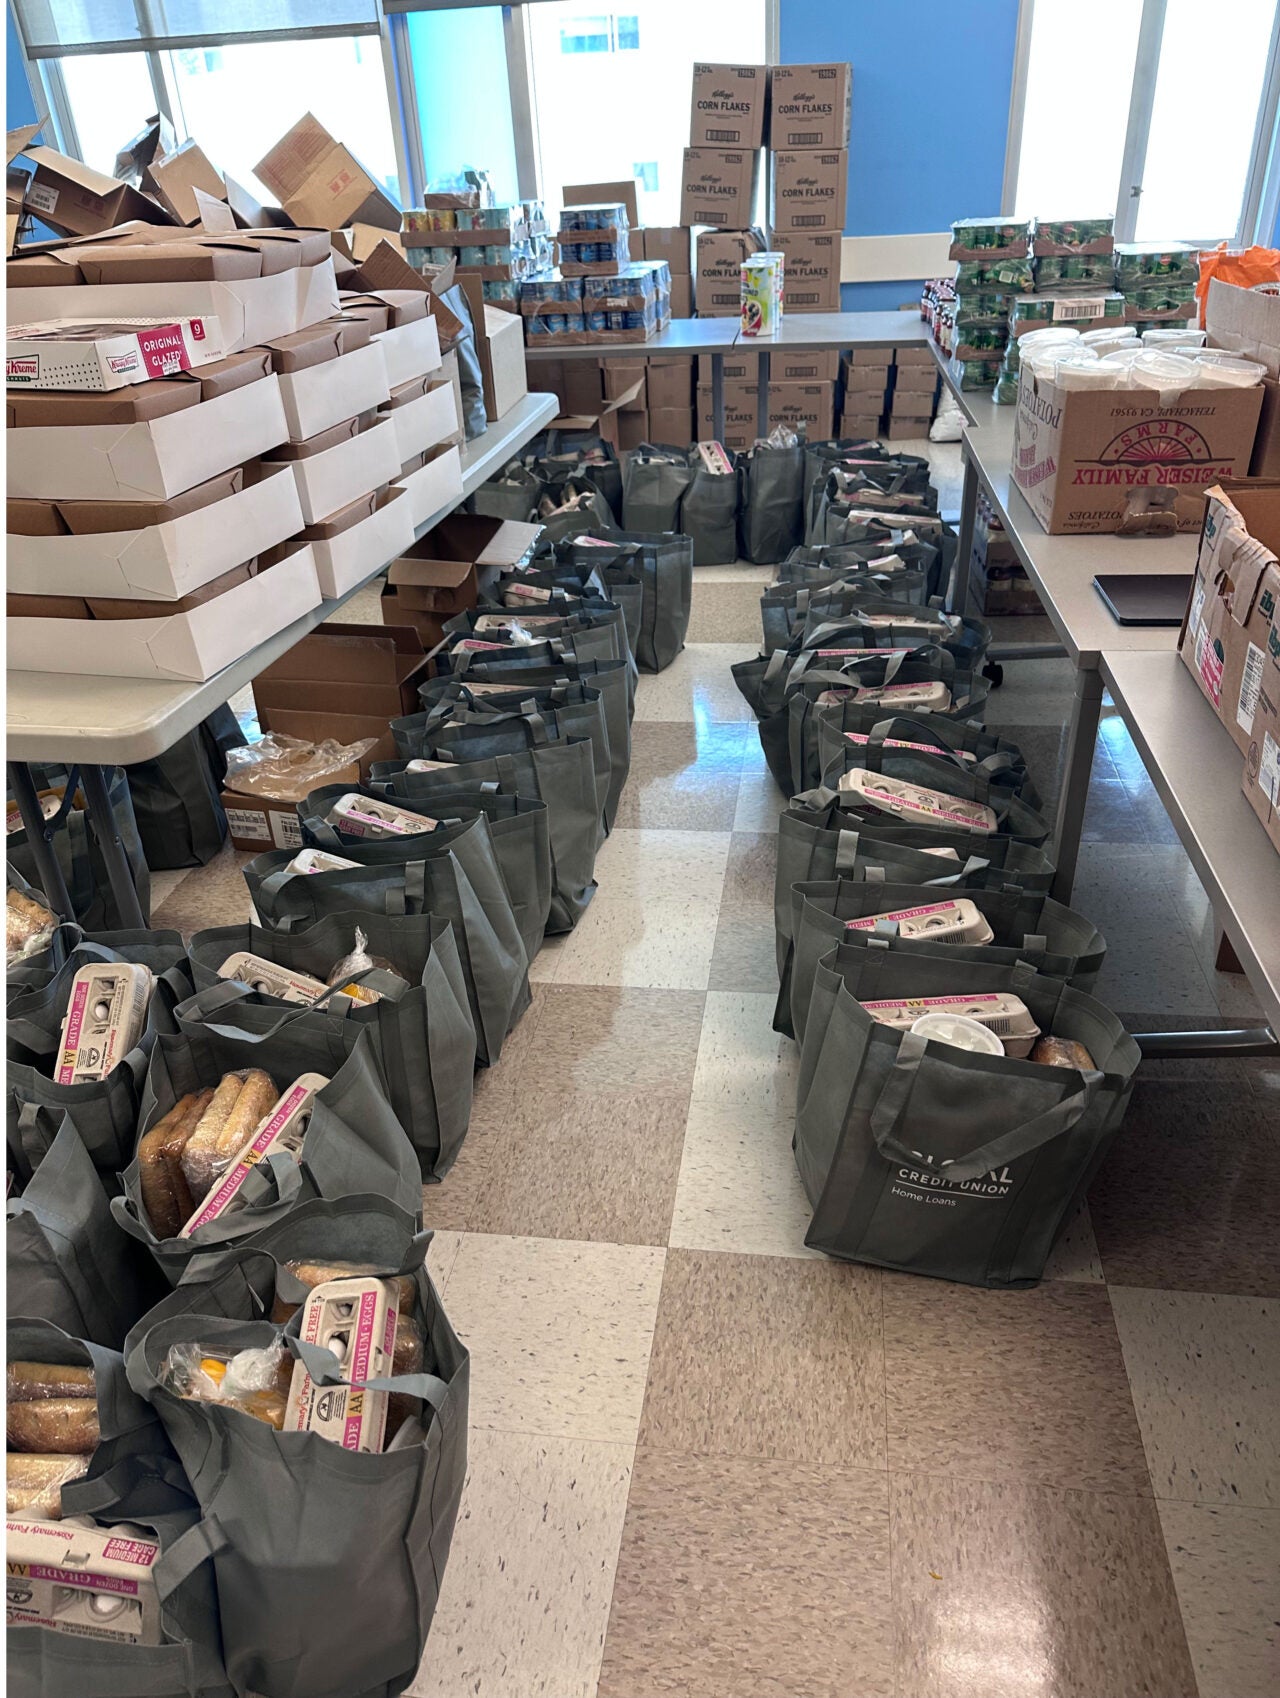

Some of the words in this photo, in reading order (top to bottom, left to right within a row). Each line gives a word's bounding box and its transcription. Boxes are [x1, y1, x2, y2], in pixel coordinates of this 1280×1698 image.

[697, 101, 719, 110] CORN
[721, 101, 750, 111] FLAKES
[778, 104, 800, 114] CORN
[802, 103, 832, 113] FLAKES
[686, 184, 707, 193] CORN
[709, 185, 737, 195] FLAKES
[782, 188, 803, 197] CORN
[806, 187, 835, 197] FLAKES
[702, 268, 721, 277] CORN
[800, 267, 828, 276] FLAKES
[194, 324, 201, 334] 9
[143, 336, 181, 352] ORIGINAL
[151, 351, 181, 367] GLAZED
[9, 360, 37, 374] Kreme
[1110, 408, 1137, 417] 93561
[1140, 408, 1153, 416] CA
[1157, 406, 1216, 416] TEHACHAPI,
[726, 414, 753, 422] FLAKES
[769, 414, 789, 422] CORN
[791, 413, 817, 422] FLAKES
[1120, 422, 1198, 447] FARMS
[1072, 468, 1149, 485] FAMILY
[893, 909, 926, 921] GRADE
[929, 997, 966, 1006] GRADE
[67, 1010, 81, 1046] GRADE
[63, 1051, 75, 1065] AA
[258, 1114, 285, 1149] GRADE
[243, 1152, 259, 1165] AA
[214, 1168, 247, 1212] MEDIUM
[960, 1181, 1010, 1195] UNION
[891, 1186, 923, 1202] Home
[925, 1195, 957, 1207] Loans
[307, 1305, 319, 1333] FREE
[349, 1393, 364, 1414] AA
[362, 1294, 376, 1327] EGGS
[30, 1527, 74, 1540] Rosemary
[109, 1539, 132, 1550] FREE
[133, 1545, 154, 1555] CAGE
[106, 1549, 137, 1563] MEDIUM
[139, 1555, 149, 1564] 12
[7, 1563, 26, 1576] AA
[36, 1567, 91, 1584] GRADE
[95, 1581, 119, 1590] DOZEN
